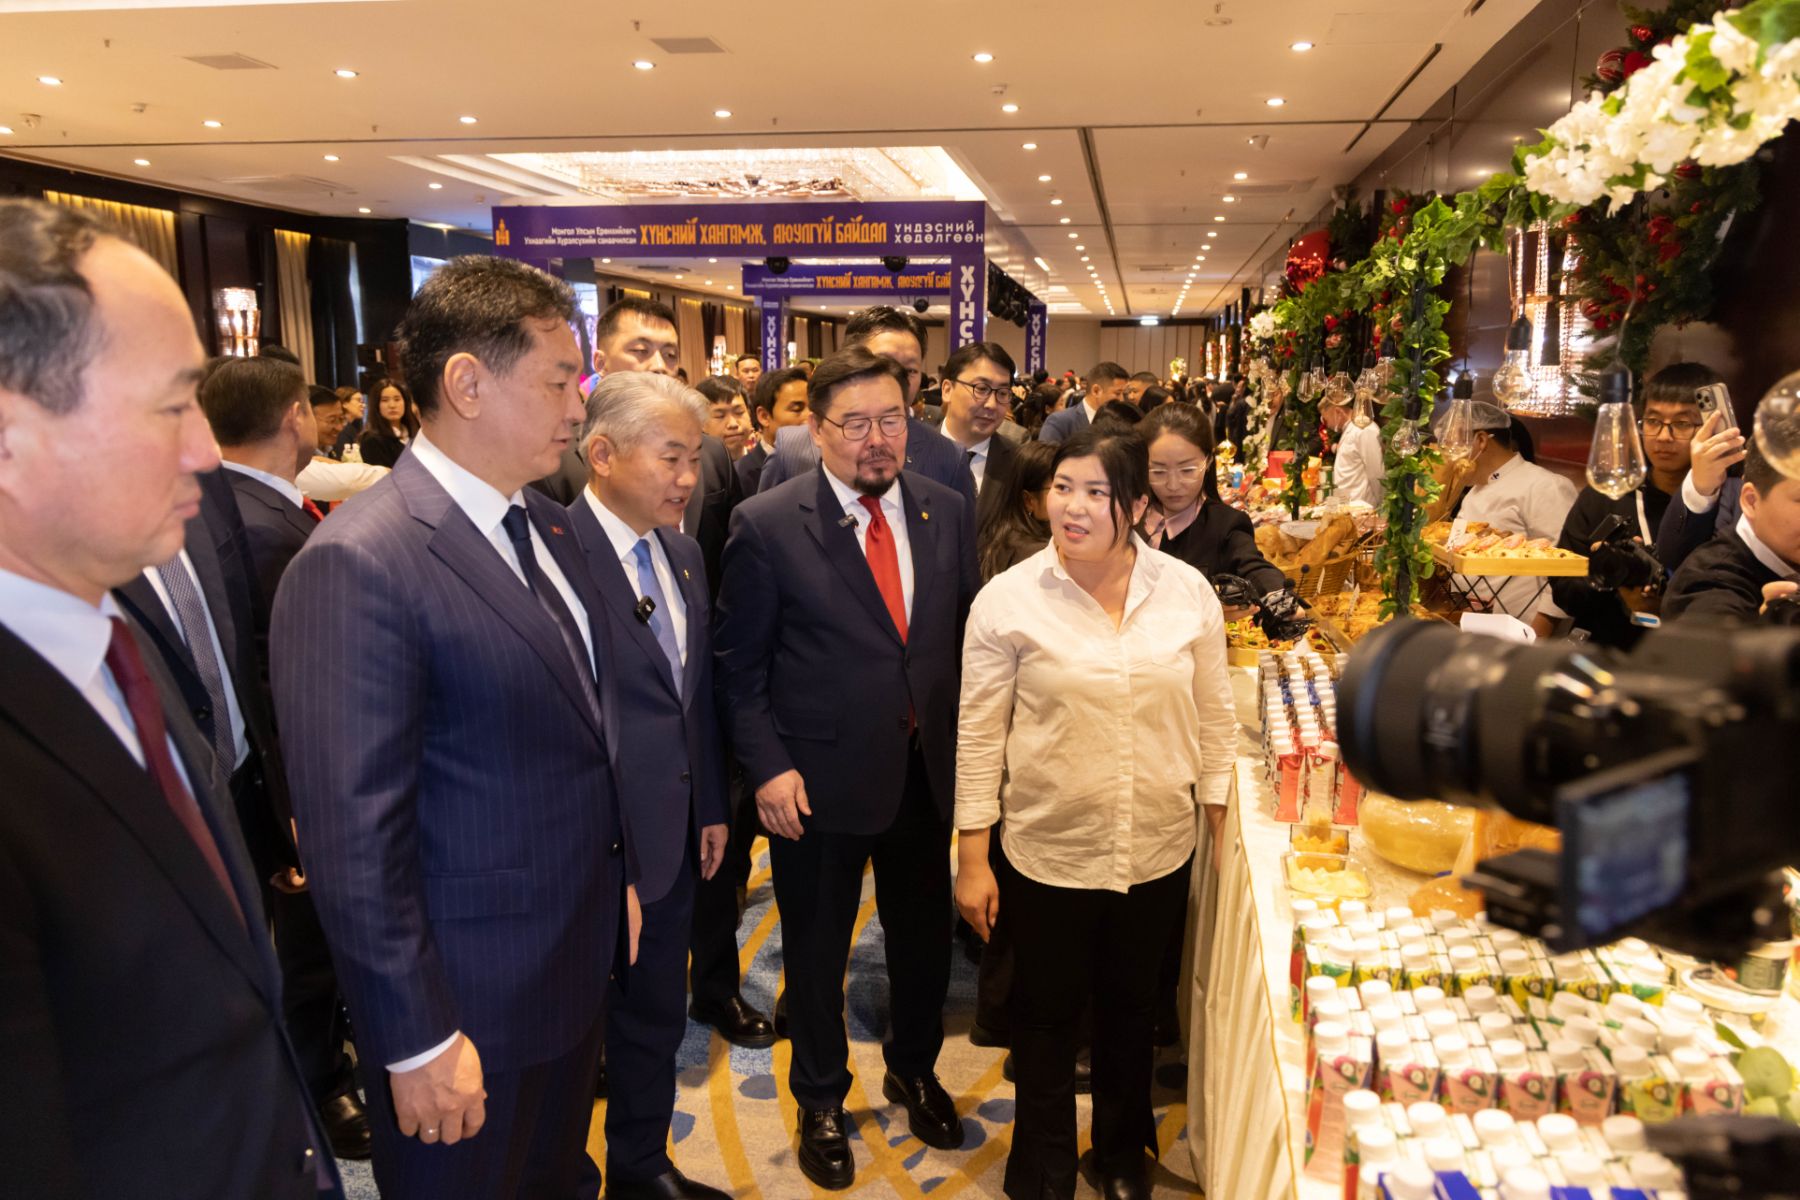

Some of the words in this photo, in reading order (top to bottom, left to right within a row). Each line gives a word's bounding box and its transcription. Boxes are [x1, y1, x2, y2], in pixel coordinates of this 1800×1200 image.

[640, 217, 698, 245] ХҮНСНИЙ
[700, 224, 767, 245] ХАНГАМЖ,
[773, 216, 834, 244] АЮУЛГҮЙ
[835, 215, 887, 243] БАЙДАЛ
[894, 220, 975, 233] ҮНДЭСНИЙ
[894, 233, 984, 244] ХӨДӨЛГӨӨН
